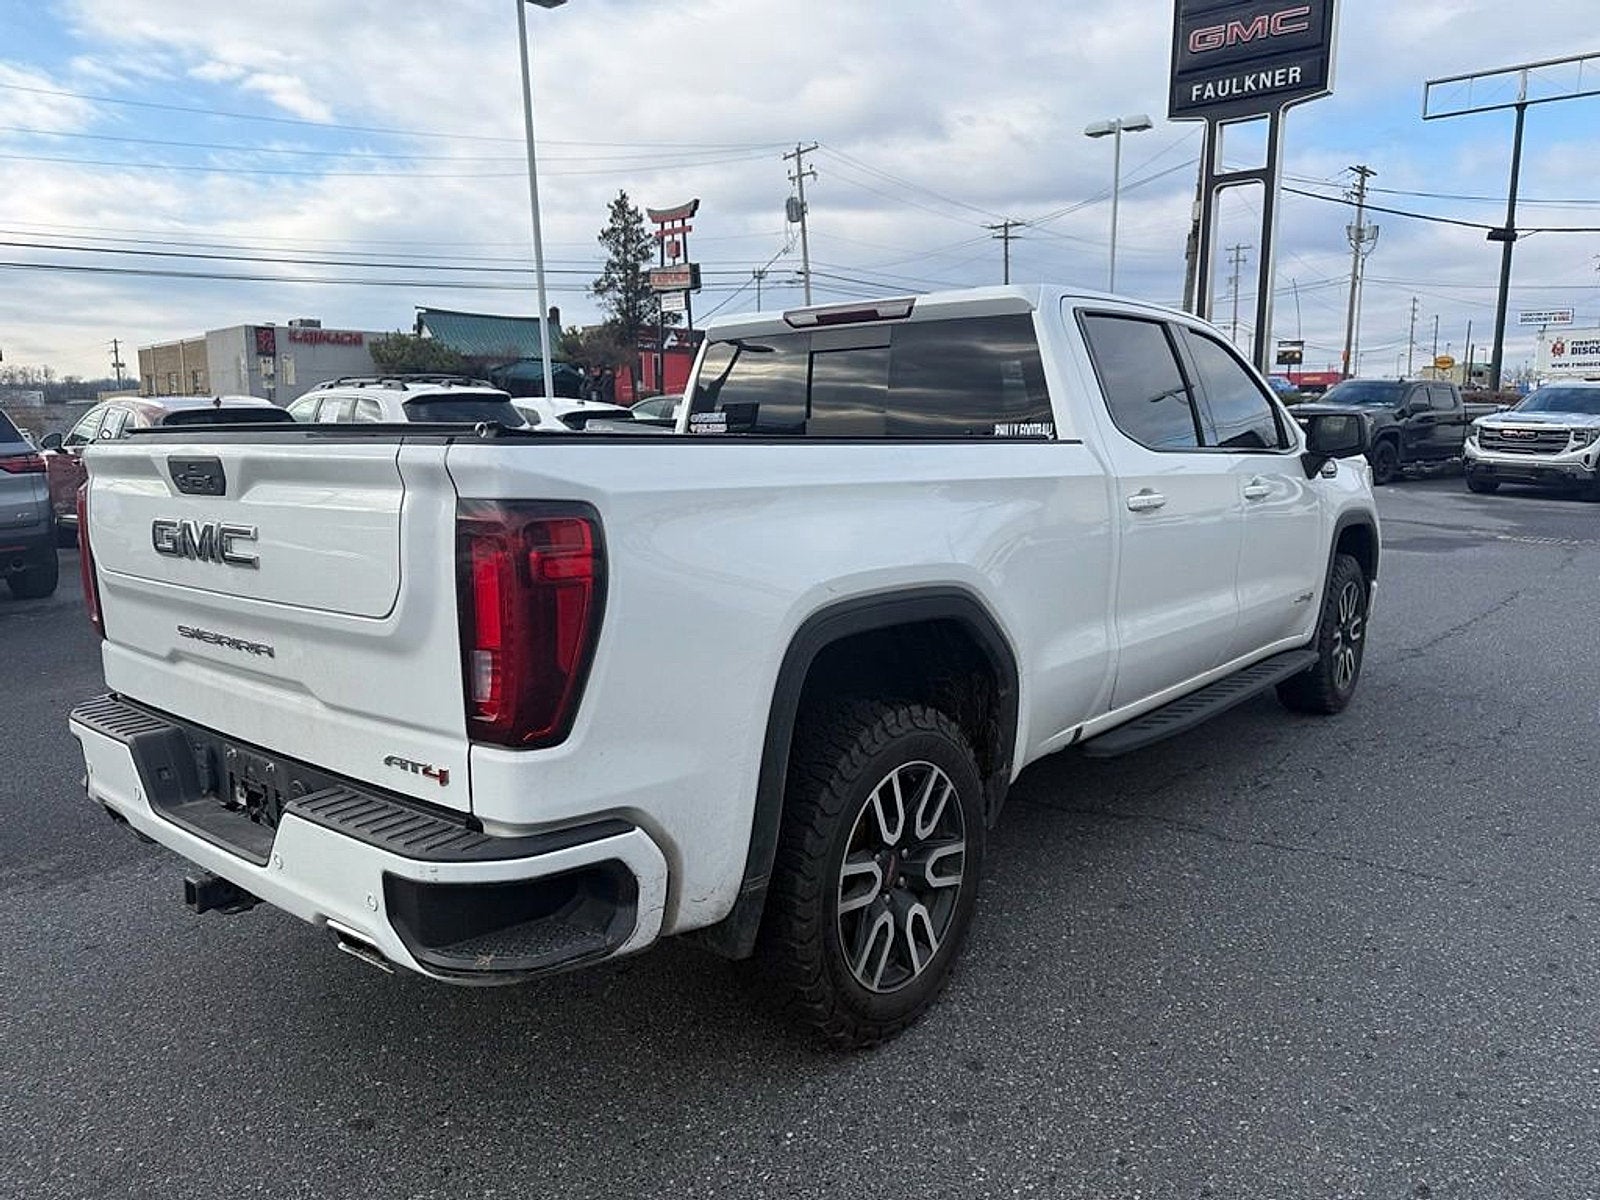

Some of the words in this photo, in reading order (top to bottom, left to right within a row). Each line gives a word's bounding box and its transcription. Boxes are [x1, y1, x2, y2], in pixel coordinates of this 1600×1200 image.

[1189, 6, 1310, 52] GMC
[1191, 66, 1302, 101] FAULKNER
[152, 519, 260, 570] GMC
[178, 625, 275, 658] SIERRA
[384, 755, 450, 787] AT4
